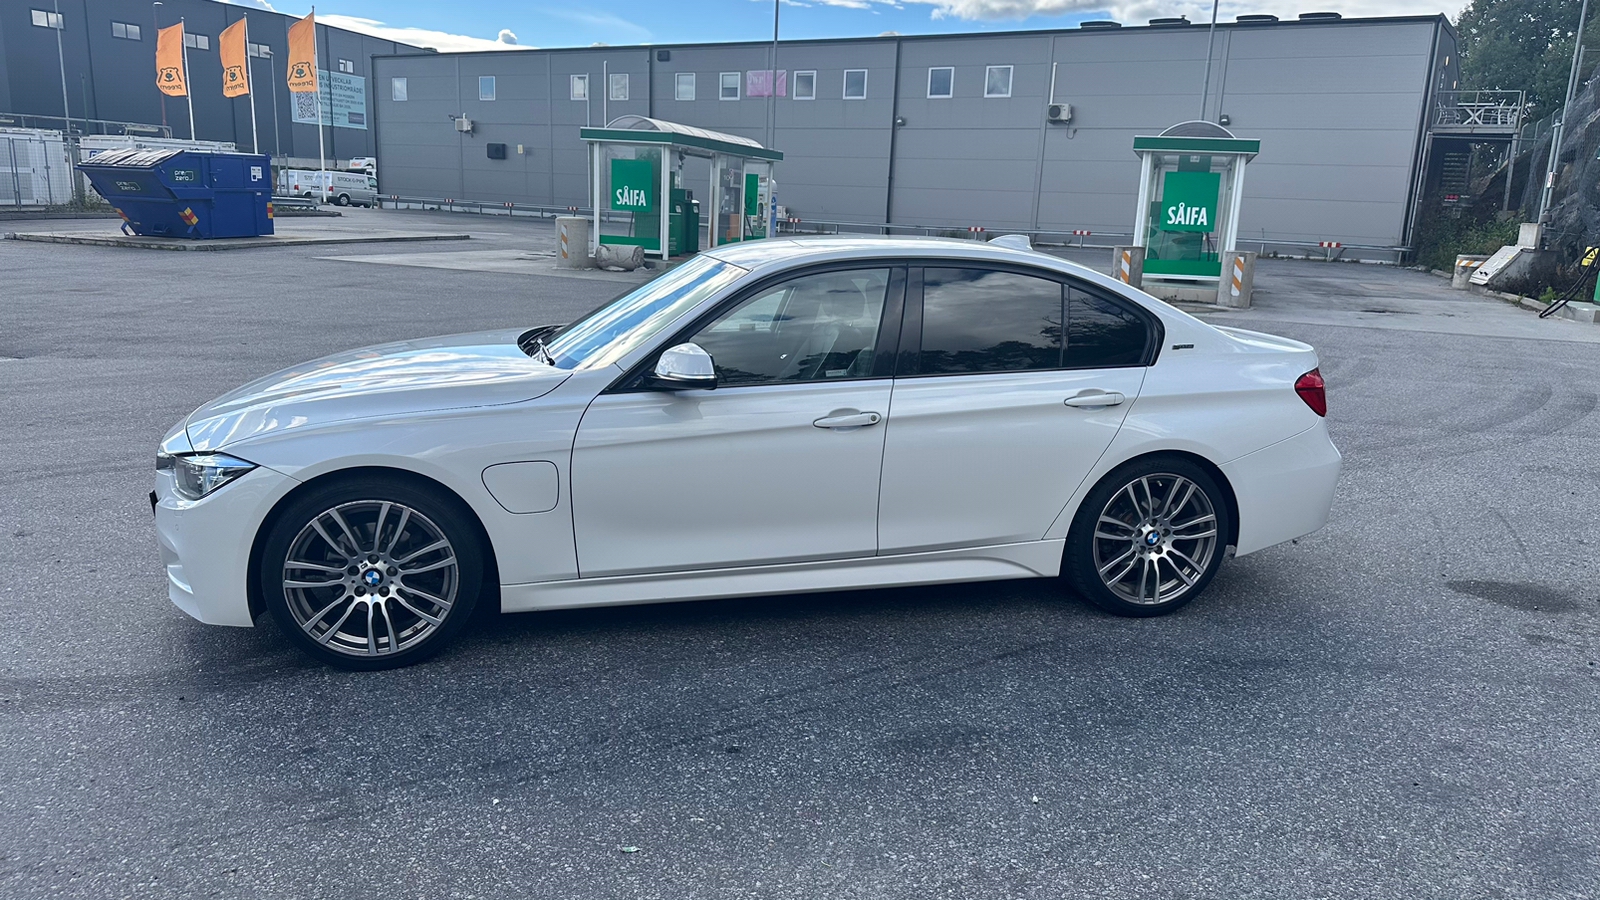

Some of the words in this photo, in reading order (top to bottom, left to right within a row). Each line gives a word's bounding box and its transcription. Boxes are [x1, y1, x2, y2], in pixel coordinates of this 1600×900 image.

[326, 75, 351, 84] UVECKLAR
[324, 82, 363, 94] INUSTRIOMRÅDE!
[616, 185, 646, 206] SÅIFA
[1167, 202, 1208, 226] SÅIFA
